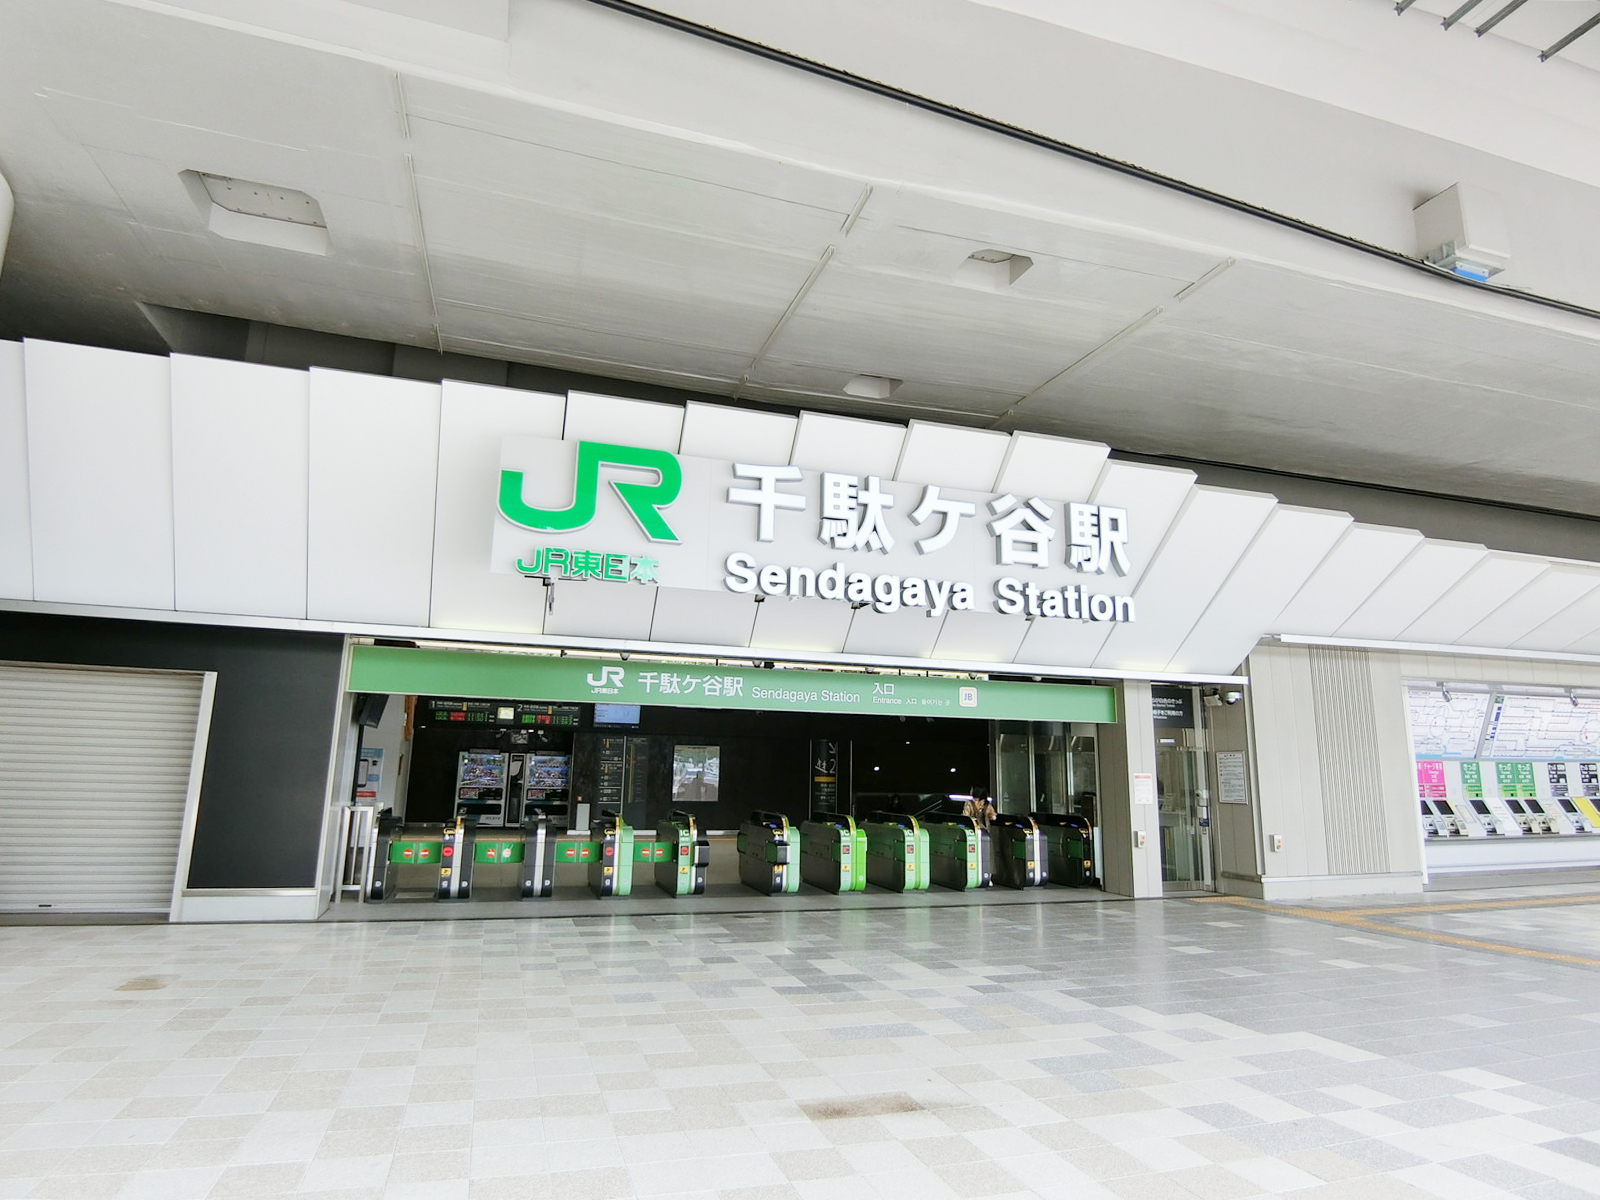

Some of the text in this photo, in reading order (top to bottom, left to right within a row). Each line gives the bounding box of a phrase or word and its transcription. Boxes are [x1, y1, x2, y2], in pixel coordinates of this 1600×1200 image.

[498, 440, 683, 545] JR
[515, 546, 661, 584] JR東日本
[724, 552, 1137, 623] Sendagaya Station
[587, 667, 625, 687] JR
[752, 687, 860, 703] Sendagaya Station
[872, 682, 895, 695] 入口
[964, 692, 973, 701] JB
[872, 696, 902, 705] Entrance
